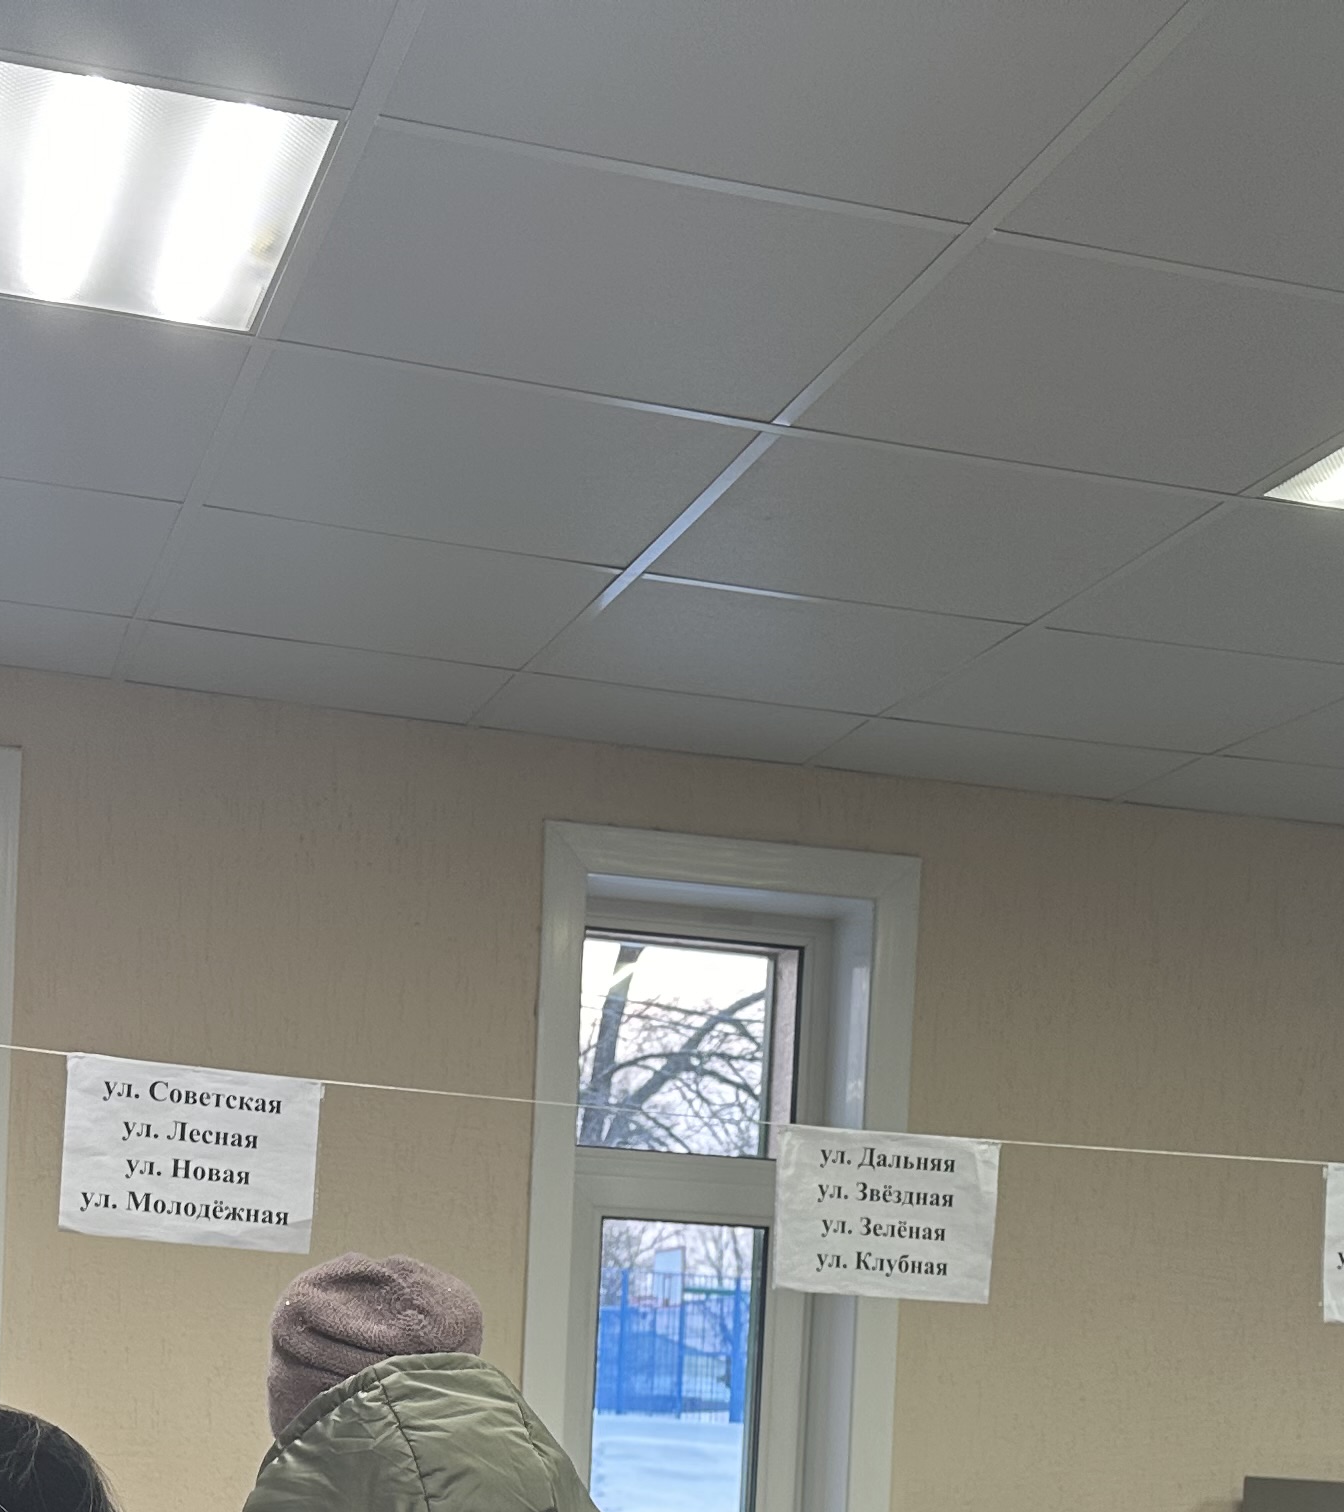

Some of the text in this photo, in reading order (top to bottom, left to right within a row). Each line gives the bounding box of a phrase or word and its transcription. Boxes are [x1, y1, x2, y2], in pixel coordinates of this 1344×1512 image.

[102, 1080, 283, 1115] ул. Советская
[122, 1120, 258, 1150] ул. Лесная
[125, 1158, 251, 1185] ул. Новая
[819, 1147, 955, 1173] ул. Дальняя
[817, 1181, 954, 1208] ул. Звёздная
[80, 1191, 289, 1226] ул. Молодёжная
[821, 1216, 946, 1242] ул. Зелёная
[816, 1251, 948, 1277] ул. Клубная
